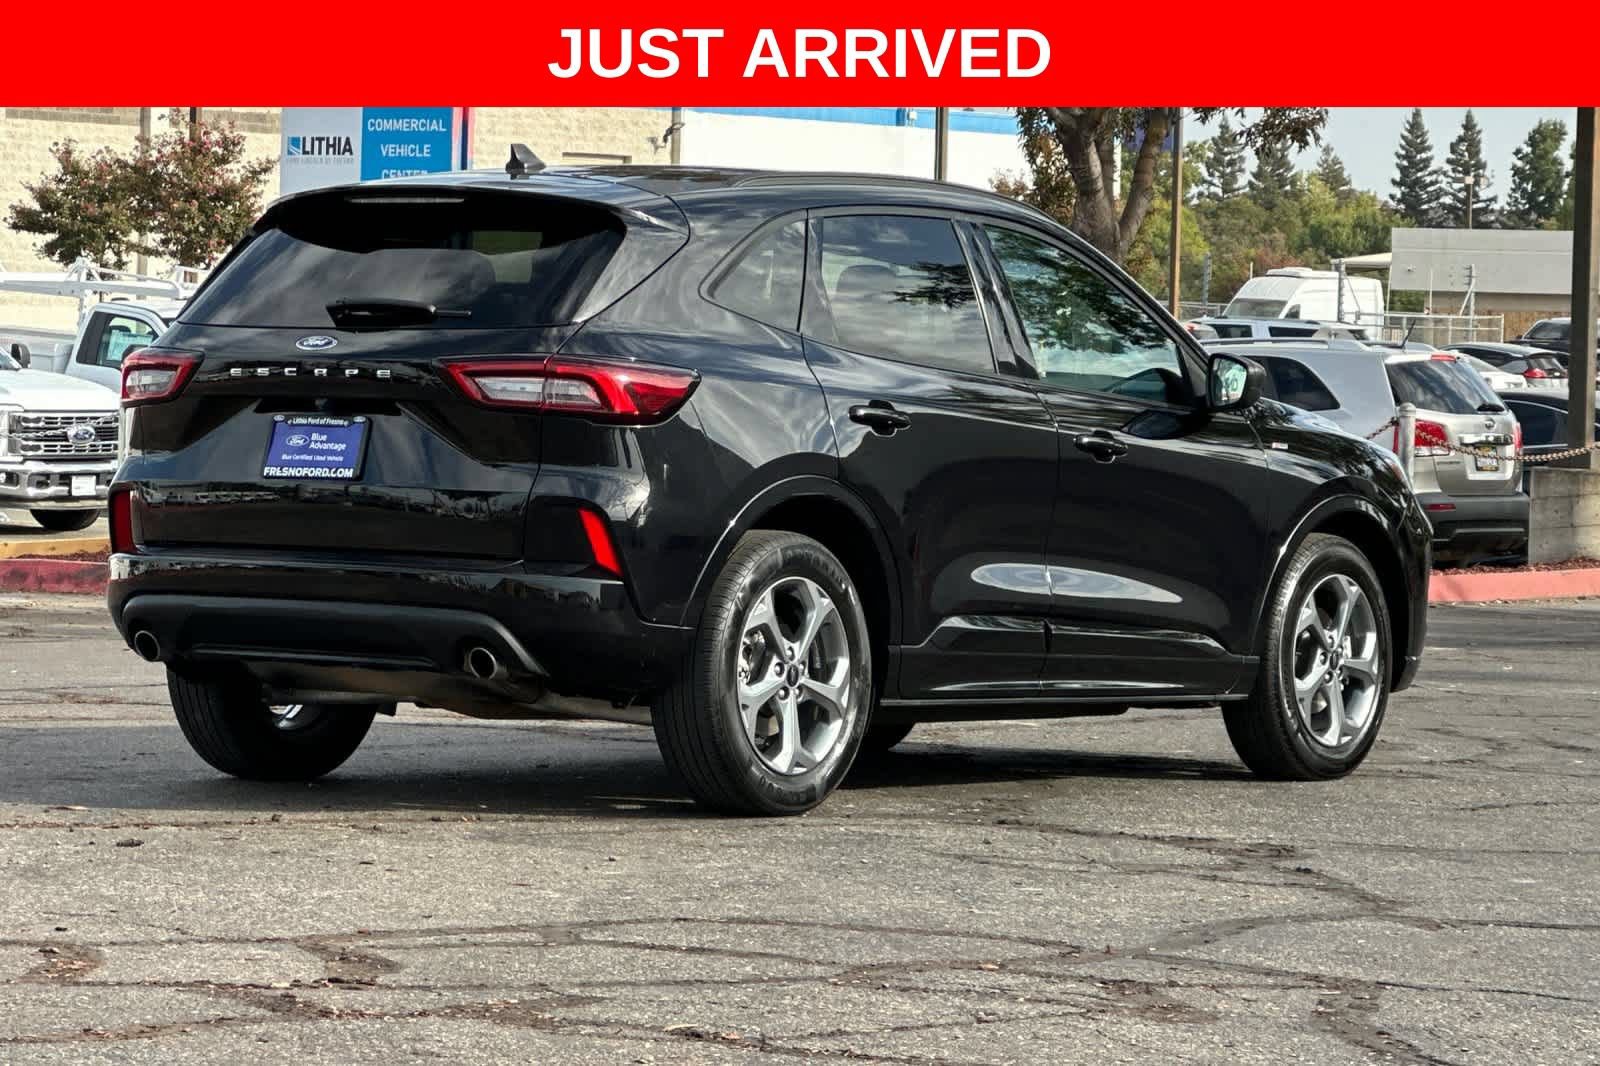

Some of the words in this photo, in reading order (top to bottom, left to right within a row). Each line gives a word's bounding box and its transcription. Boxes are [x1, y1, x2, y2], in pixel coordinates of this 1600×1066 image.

[367, 118, 447, 132] COMMERCIAL
[302, 136, 353, 155] LITHIA
[380, 144, 431, 157] VEHICLE
[230, 367, 391, 378] ESCAPE
[311, 433, 327, 441] Blue
[309, 442, 346, 451] Advantage
[263, 466, 354, 478] FRESNOFORD.COM
